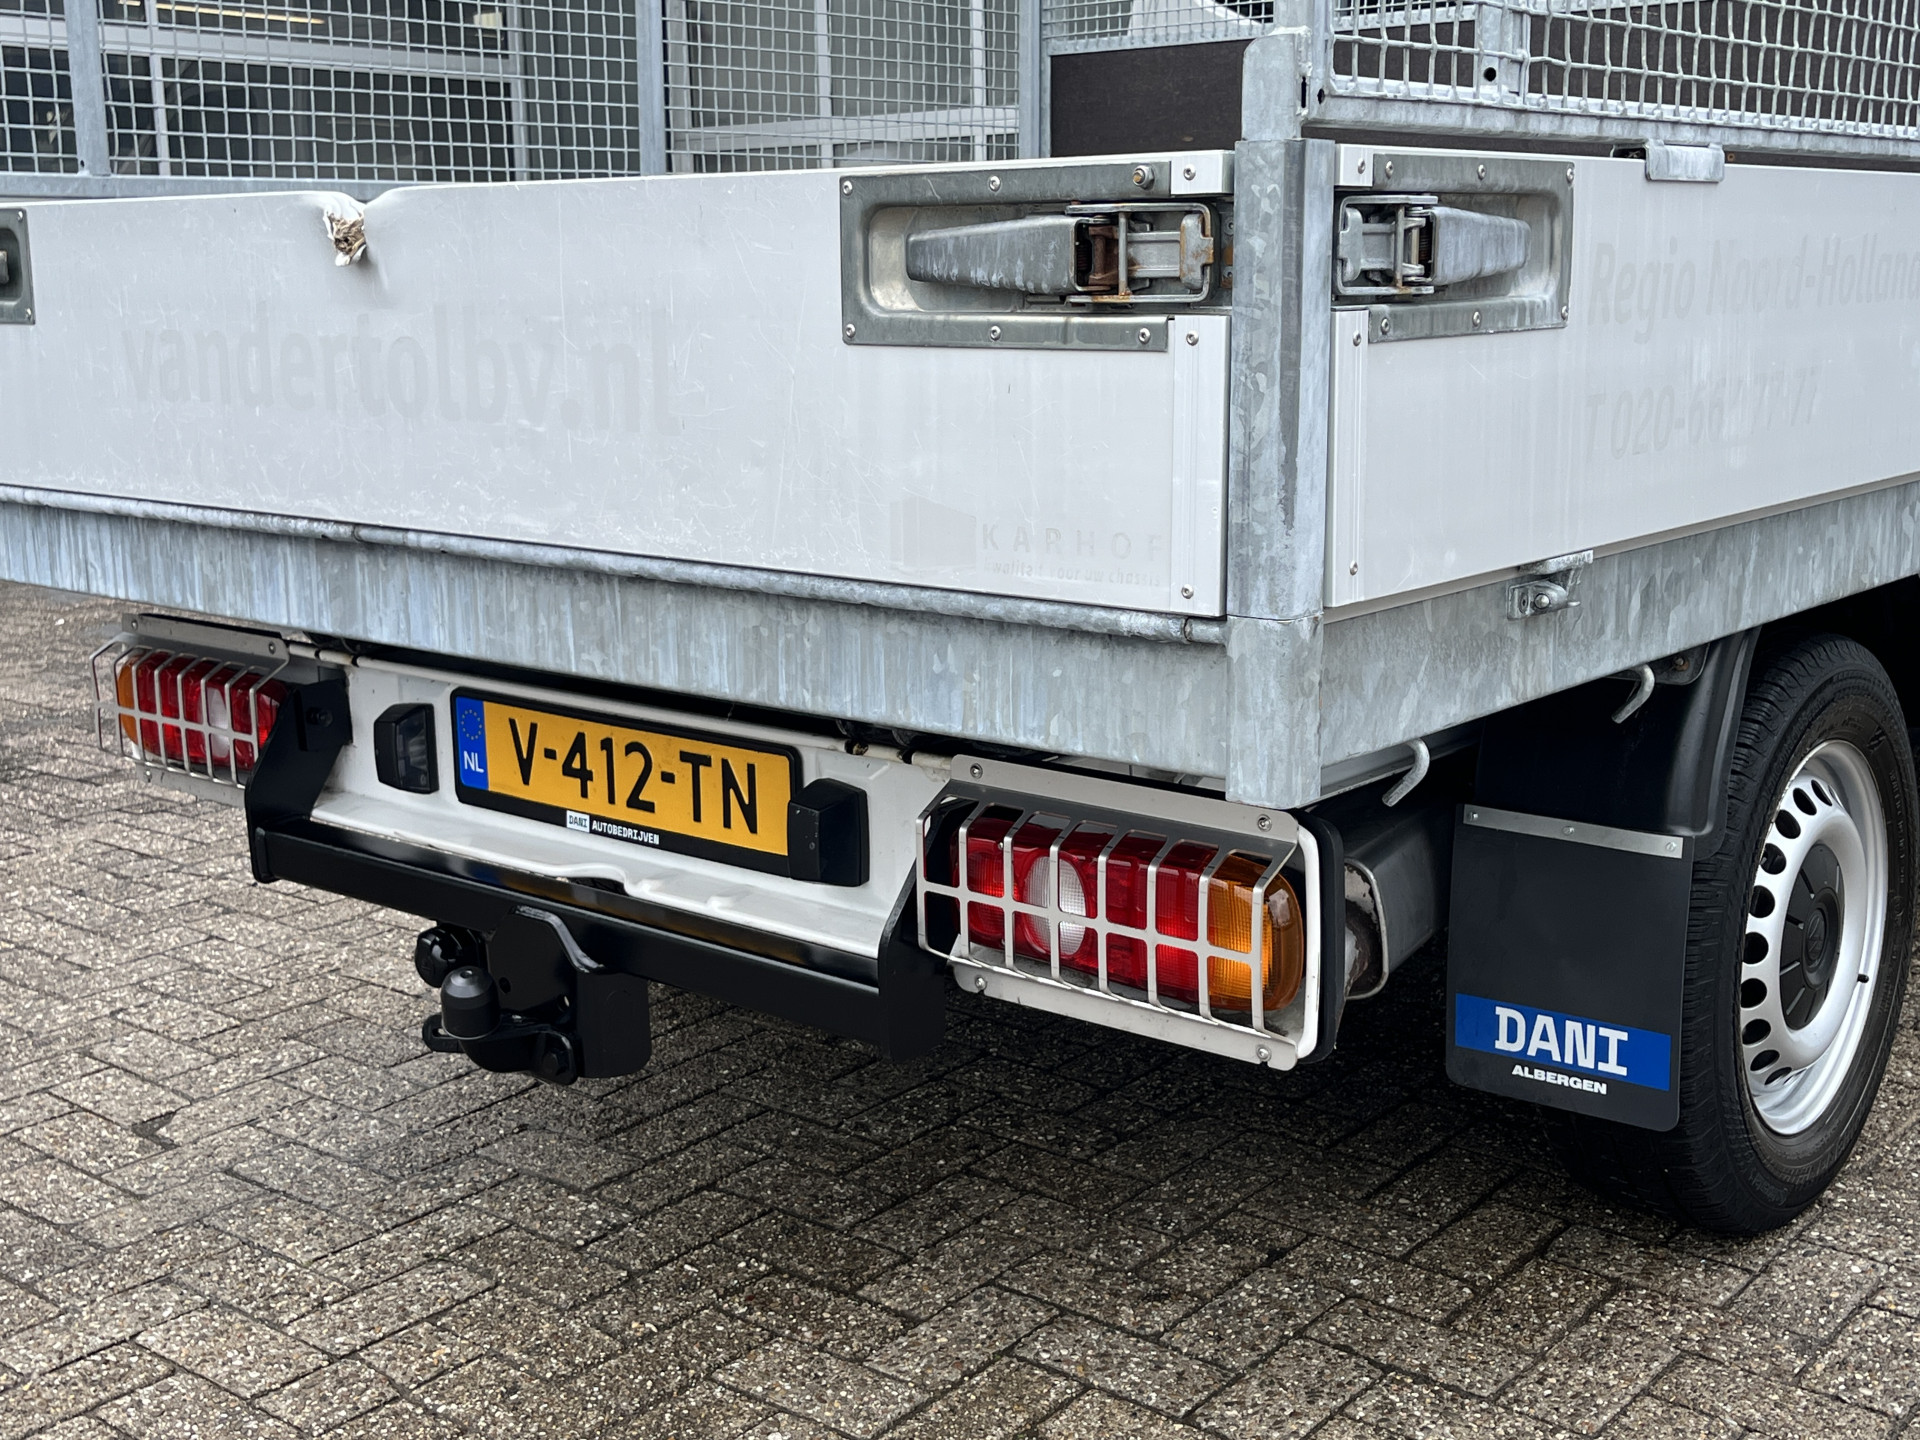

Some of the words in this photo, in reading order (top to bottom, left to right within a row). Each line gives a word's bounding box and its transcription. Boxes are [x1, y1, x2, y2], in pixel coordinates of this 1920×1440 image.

[1587, 235, 1696, 345] Regio
[121, 299, 682, 437] vandertolbv.nl
[463, 749, 485, 775] NL
[508, 717, 758, 835] V-412-TN
[568, 815, 588, 828] DANI
[592, 820, 660, 845] AUTOBEDRIJVEN
[1494, 1005, 1628, 1077] DANI
[1511, 1064, 1607, 1095] ALBERGEN
